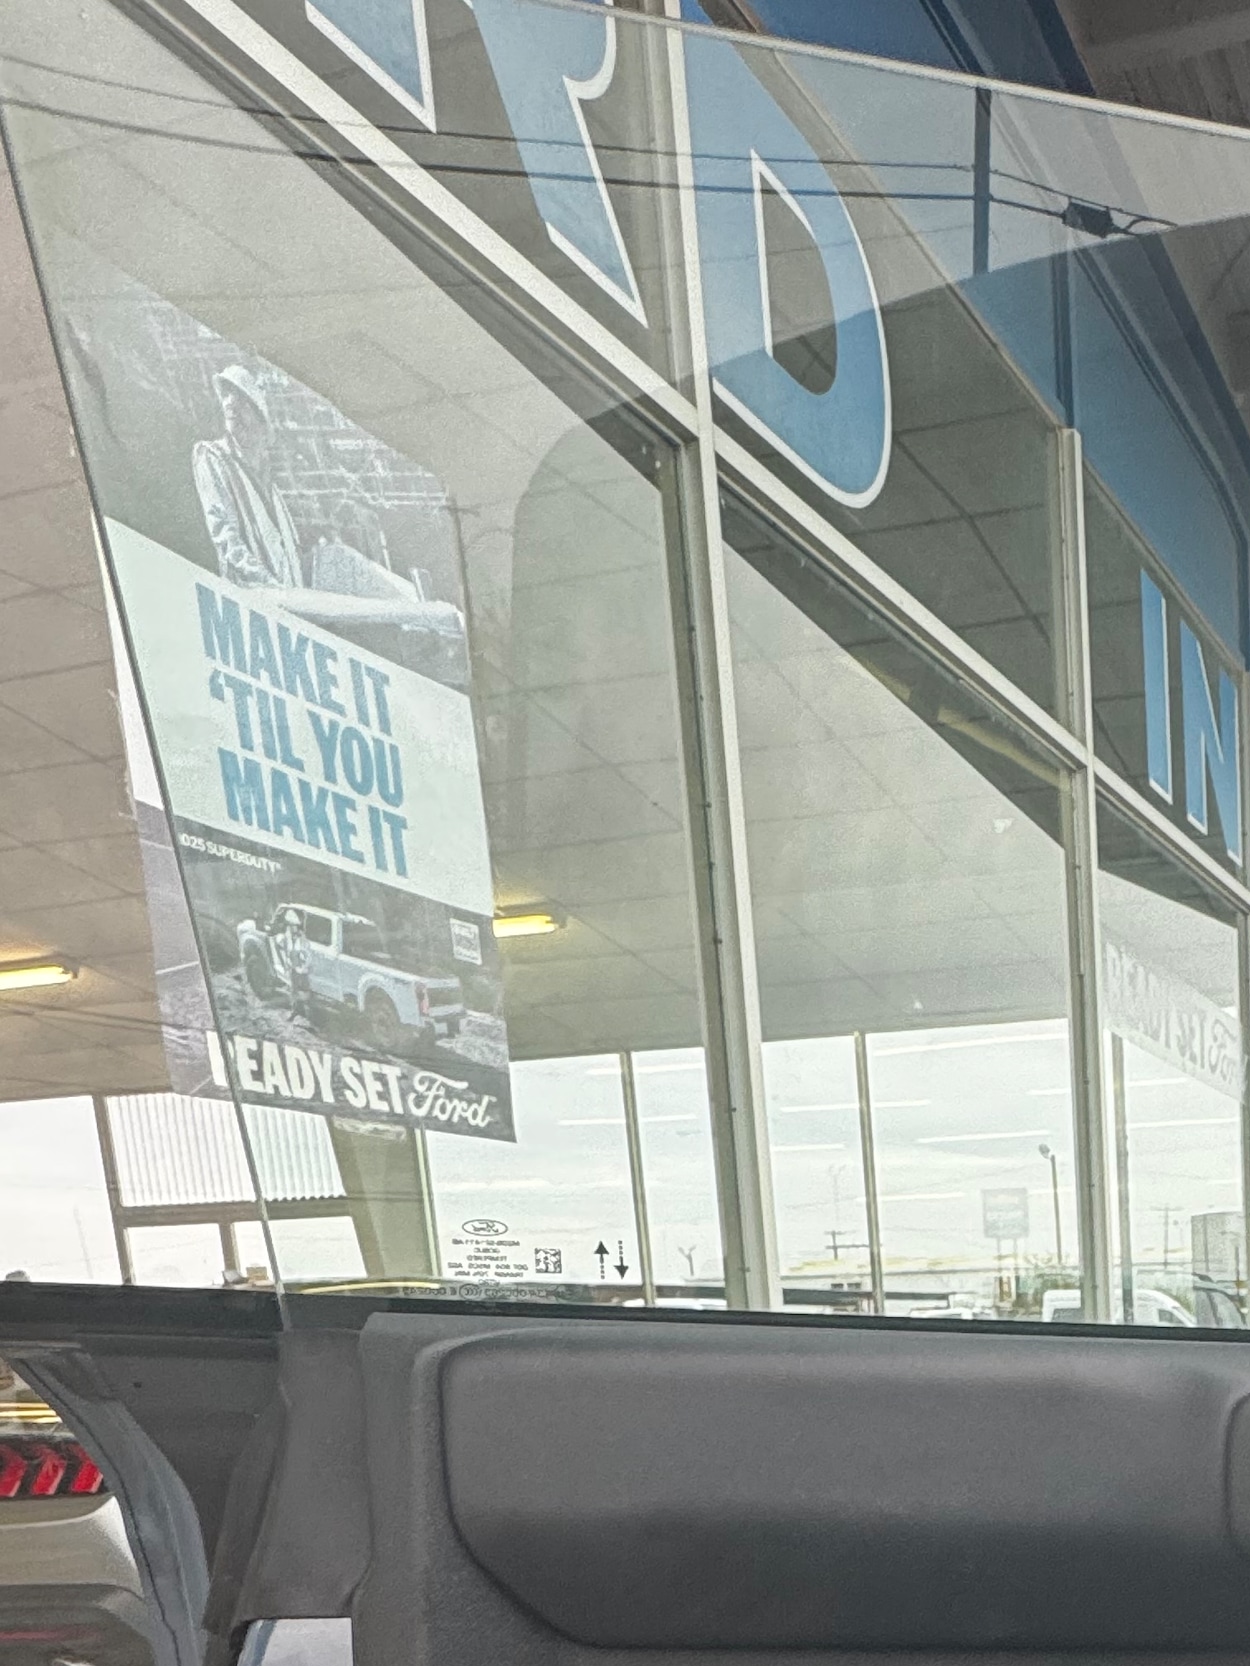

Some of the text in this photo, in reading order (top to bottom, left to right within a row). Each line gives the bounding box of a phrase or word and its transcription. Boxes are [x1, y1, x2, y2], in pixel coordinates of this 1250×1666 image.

[195, 581, 391, 738] MAKE IT
[305, 707, 405, 809] YOU
[178, 833, 206, 851] 025
[218, 746, 408, 878] MAKE IT
[339, 1057, 405, 1115] SET
[407, 1070, 497, 1128] Ford
